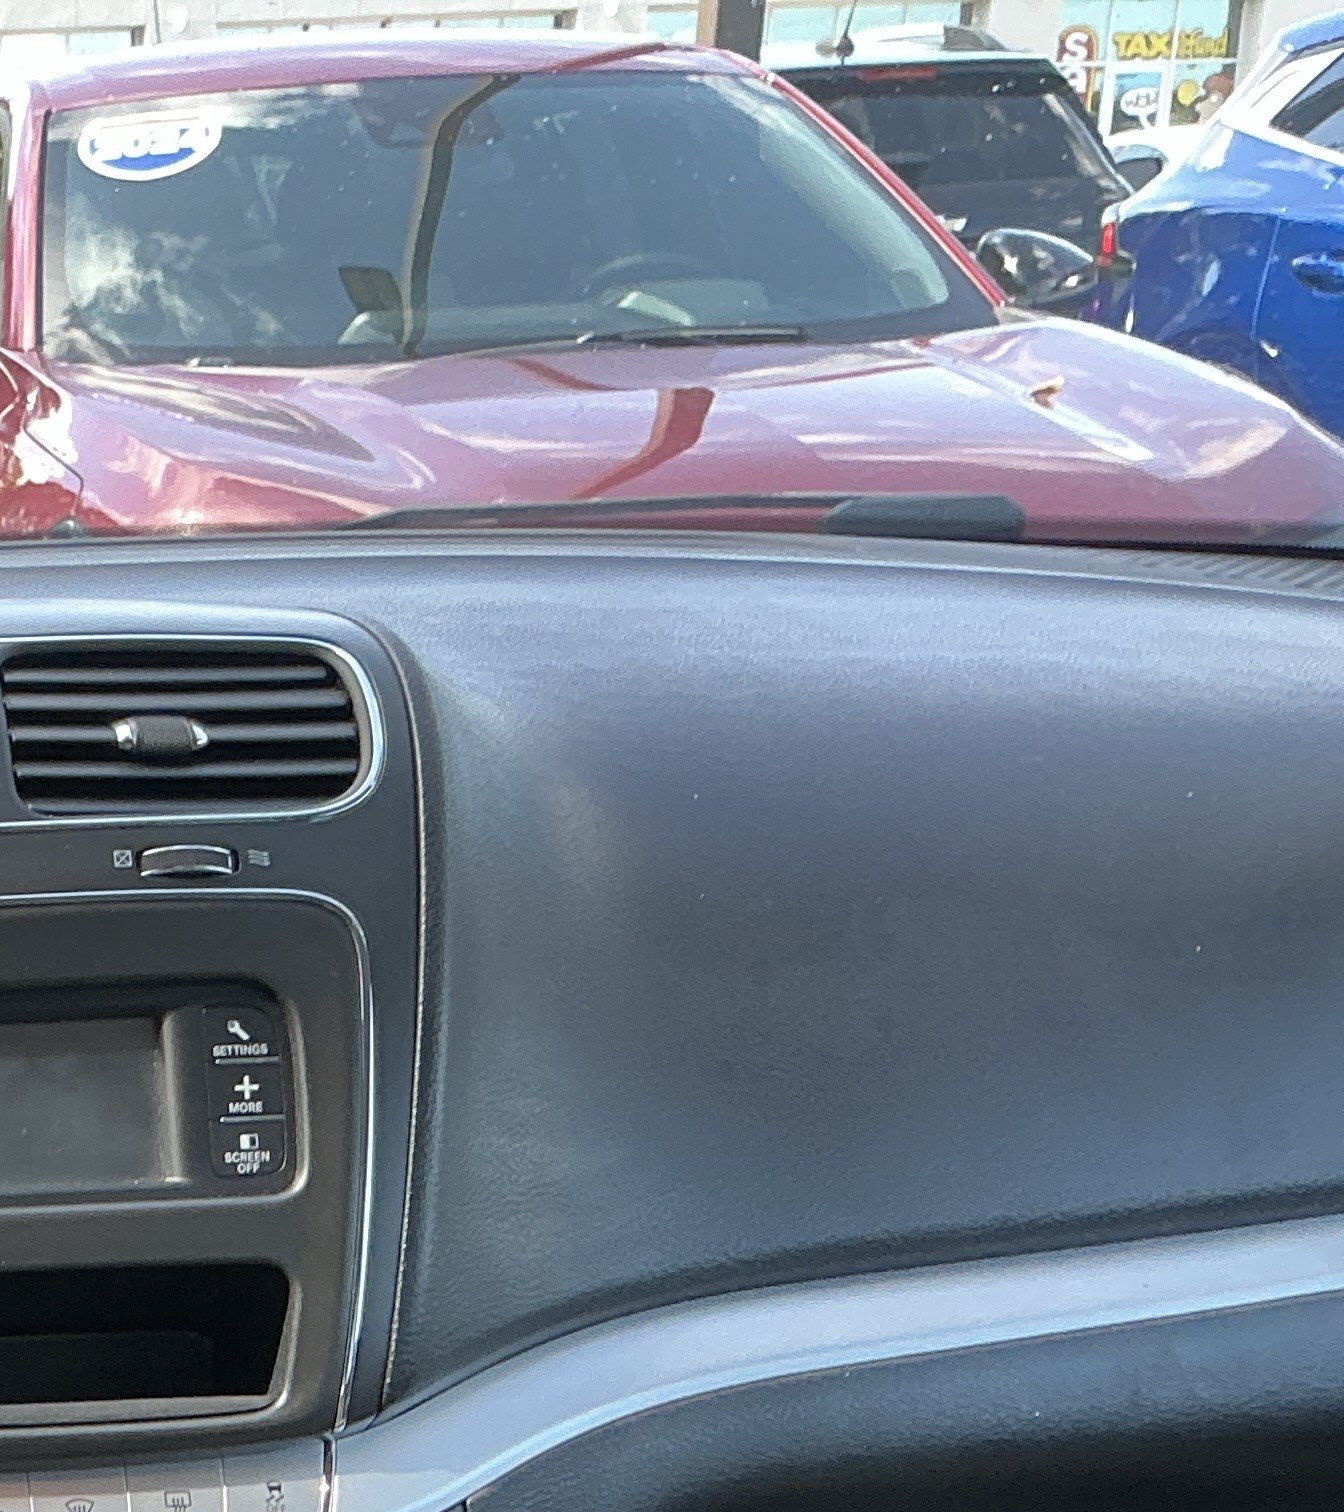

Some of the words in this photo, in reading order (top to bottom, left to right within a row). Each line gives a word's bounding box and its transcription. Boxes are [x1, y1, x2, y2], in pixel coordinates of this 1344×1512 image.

[1113, 30, 1172, 60] TAX
[212, 1042, 269, 1057] SETTINGS
[228, 1101, 264, 1115] MORE
[223, 1150, 271, 1164] SCREEN
[236, 1162, 261, 1175] OFF
